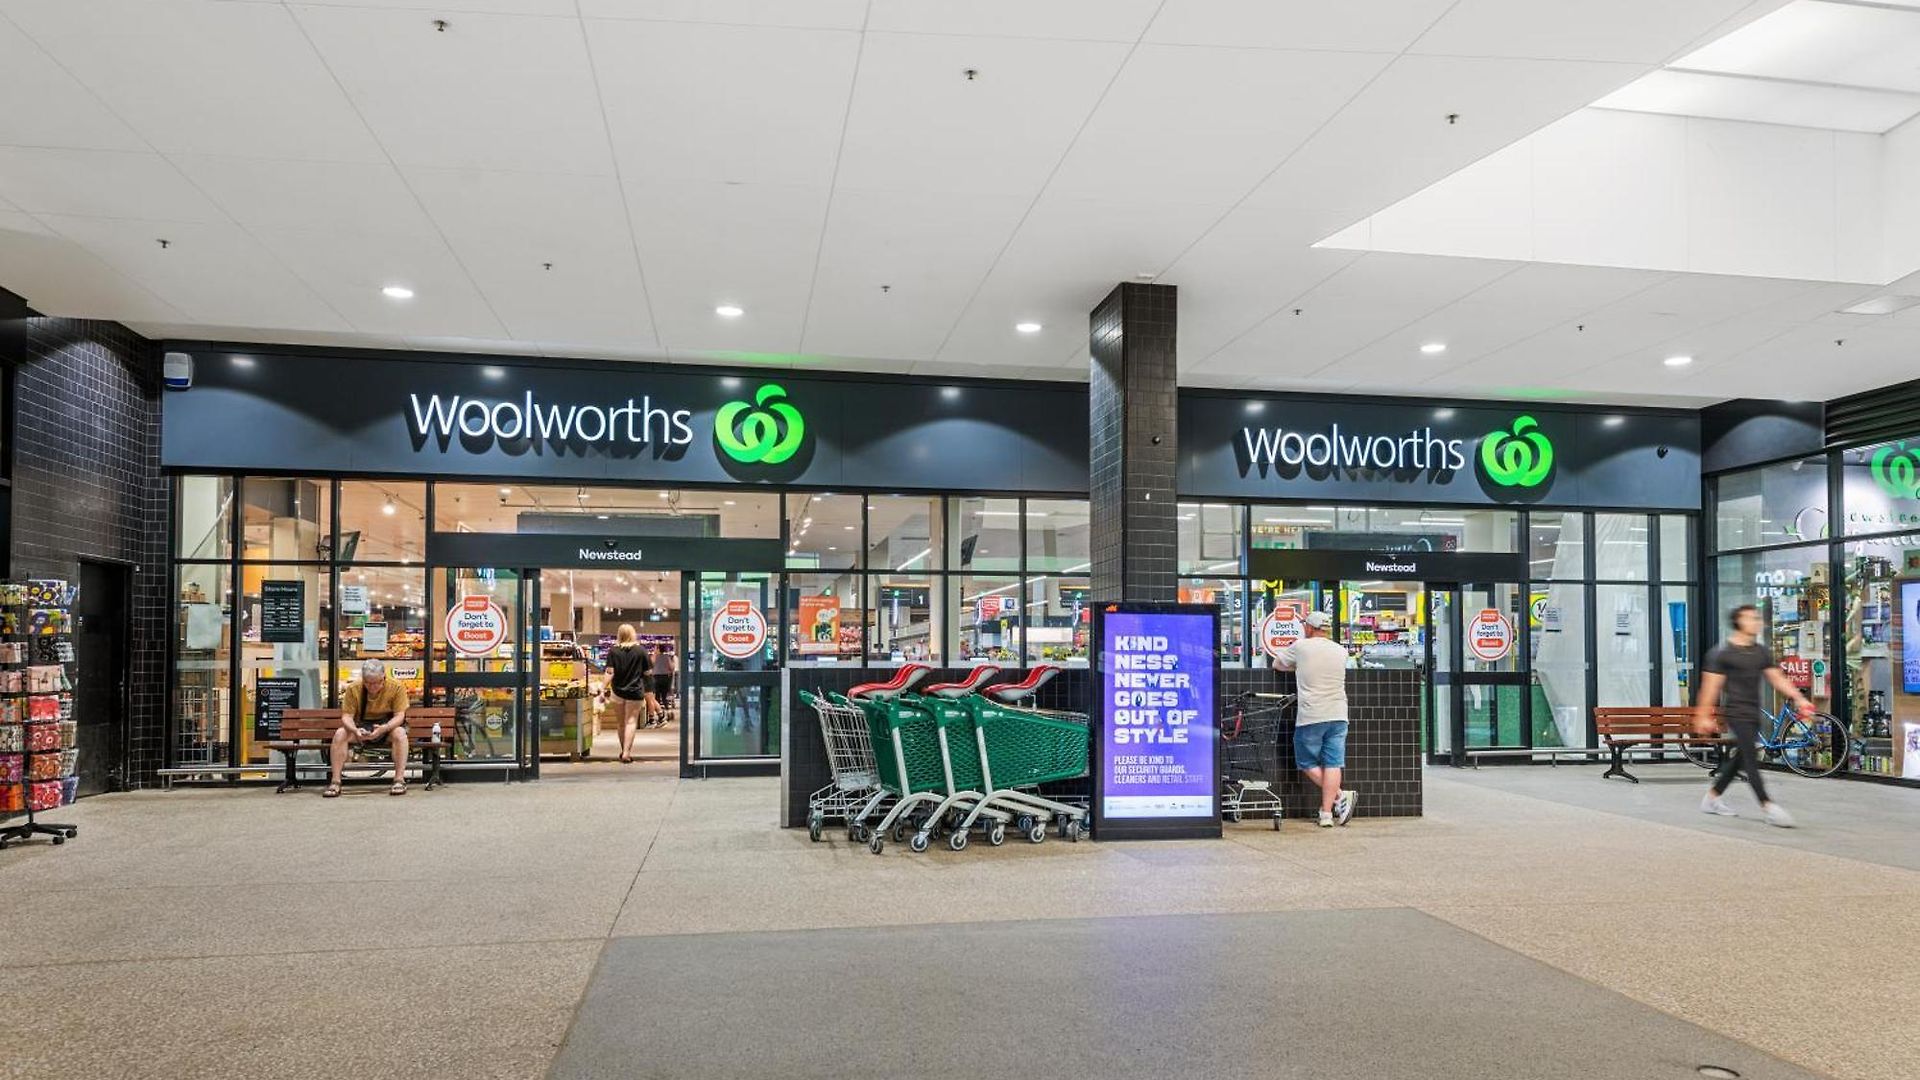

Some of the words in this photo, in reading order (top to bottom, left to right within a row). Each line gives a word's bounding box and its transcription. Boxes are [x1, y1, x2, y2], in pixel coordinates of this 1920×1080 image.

[410, 390, 693, 444] Woolworths
[1244, 423, 1465, 469] Woolworths
[579, 548, 642, 561] Newstead
[1366, 561, 1416, 573] Newstead
[1234, 598, 1241, 608] 3
[1365, 599, 1373, 609] 4
[458, 620, 483, 629] forget
[727, 616, 750, 624] Don't
[722, 623, 746, 633] forget
[746, 624, 756, 632] to
[1476, 630, 1495, 638] forget
[1115, 635, 1168, 651] KIND
[1115, 654, 1178, 670] NESS
[1780, 661, 1808, 673] SALE
[1115, 672, 1190, 688] NEVER
[1114, 691, 1178, 707] GOES
[1114, 709, 1159, 725] OUT
[1166, 709, 1198, 725] OF
[1114, 728, 1188, 744] STYLE
[1114, 756, 1138, 765] PLEASE
[1139, 756, 1148, 765] BE
[1149, 756, 1164, 765] KIND
[1114, 765, 1128, 774] OUR
[1128, 765, 1159, 774] SECURITY
[1114, 775, 1147, 784] CLEANERS
[1148, 775, 1161, 784] AND
